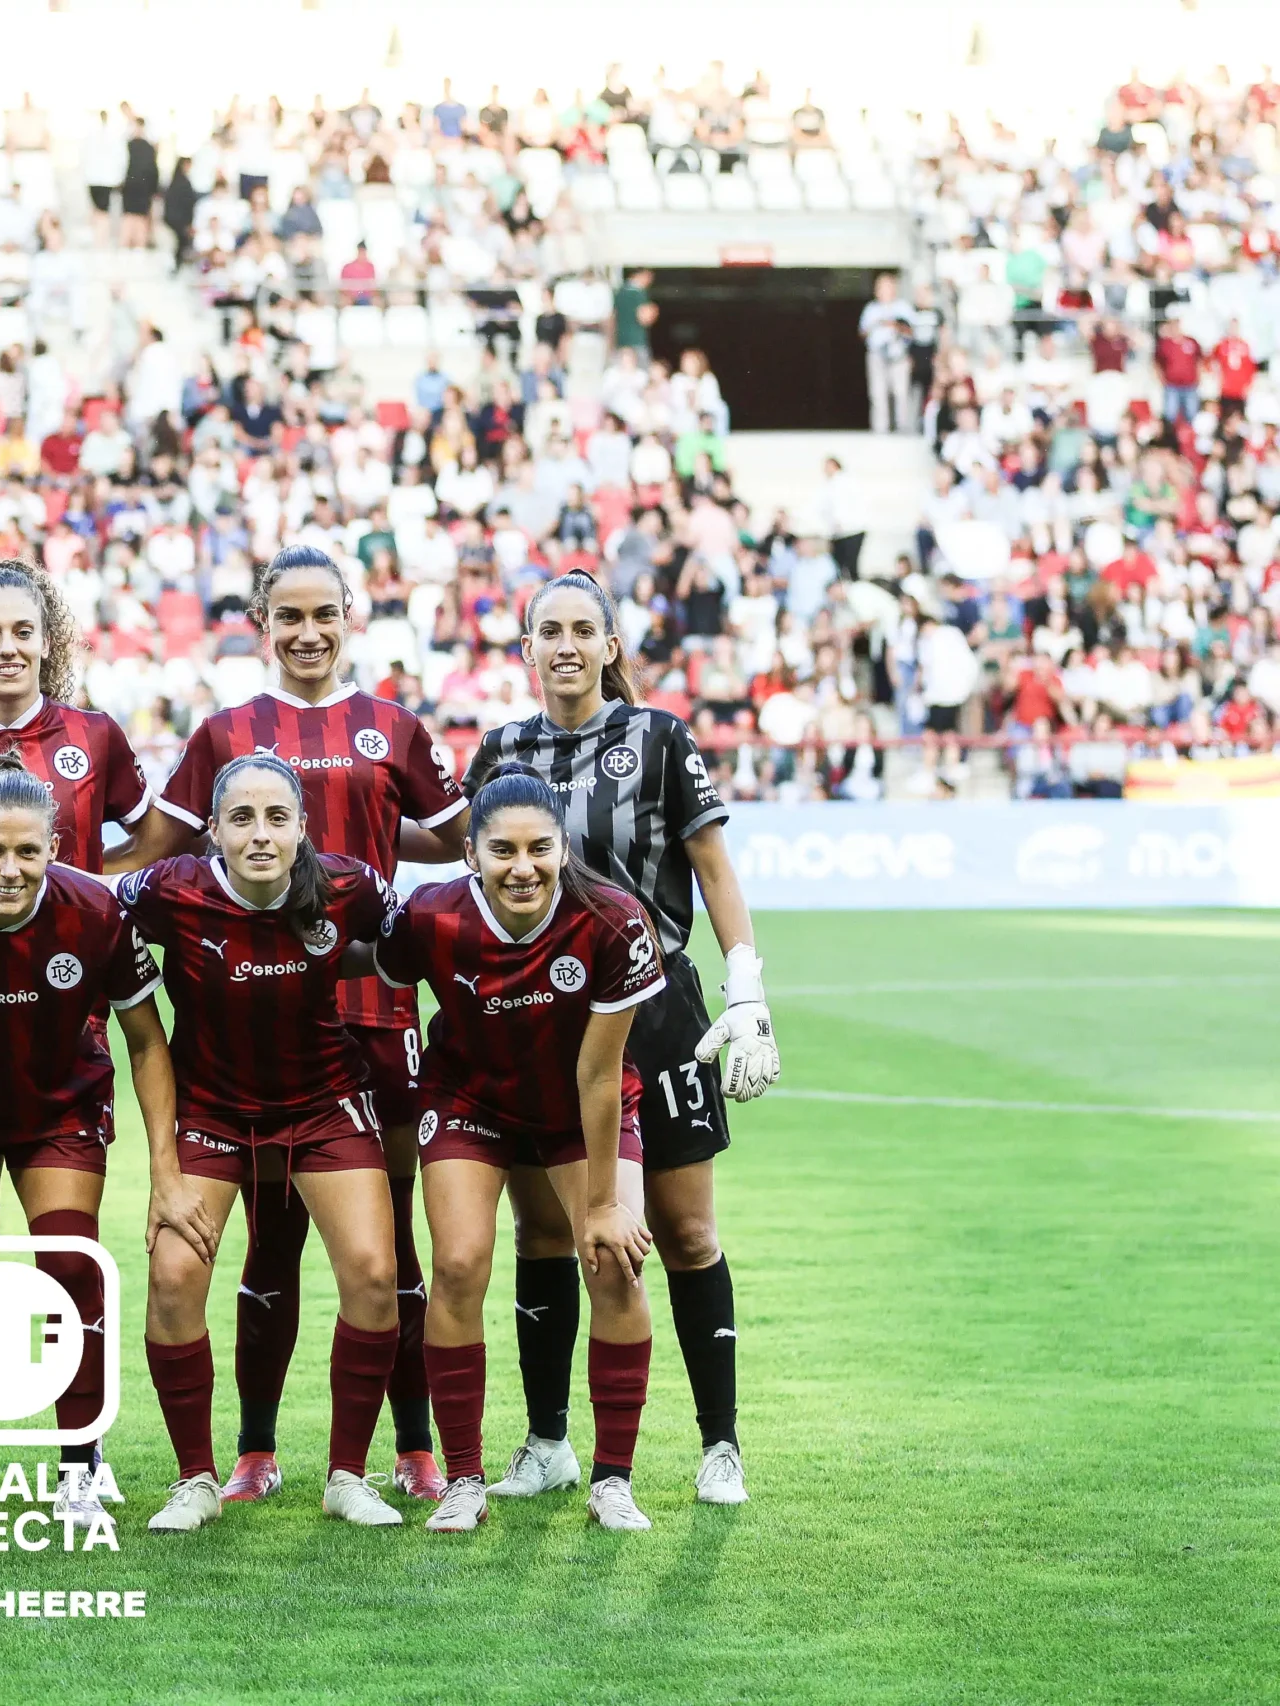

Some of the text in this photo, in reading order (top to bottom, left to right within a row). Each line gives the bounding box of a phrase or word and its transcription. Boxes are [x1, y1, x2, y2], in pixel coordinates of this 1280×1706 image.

[286, 755, 354, 769] OGROÑO
[549, 777, 598, 793] GROÑO
[235, 960, 308, 977] LOGROÑO
[486, 990, 554, 1010] LOGROÑO
[403, 1028, 420, 1077] 8
[658, 1060, 705, 1119] 13
[203, 1135, 216, 1149] La
